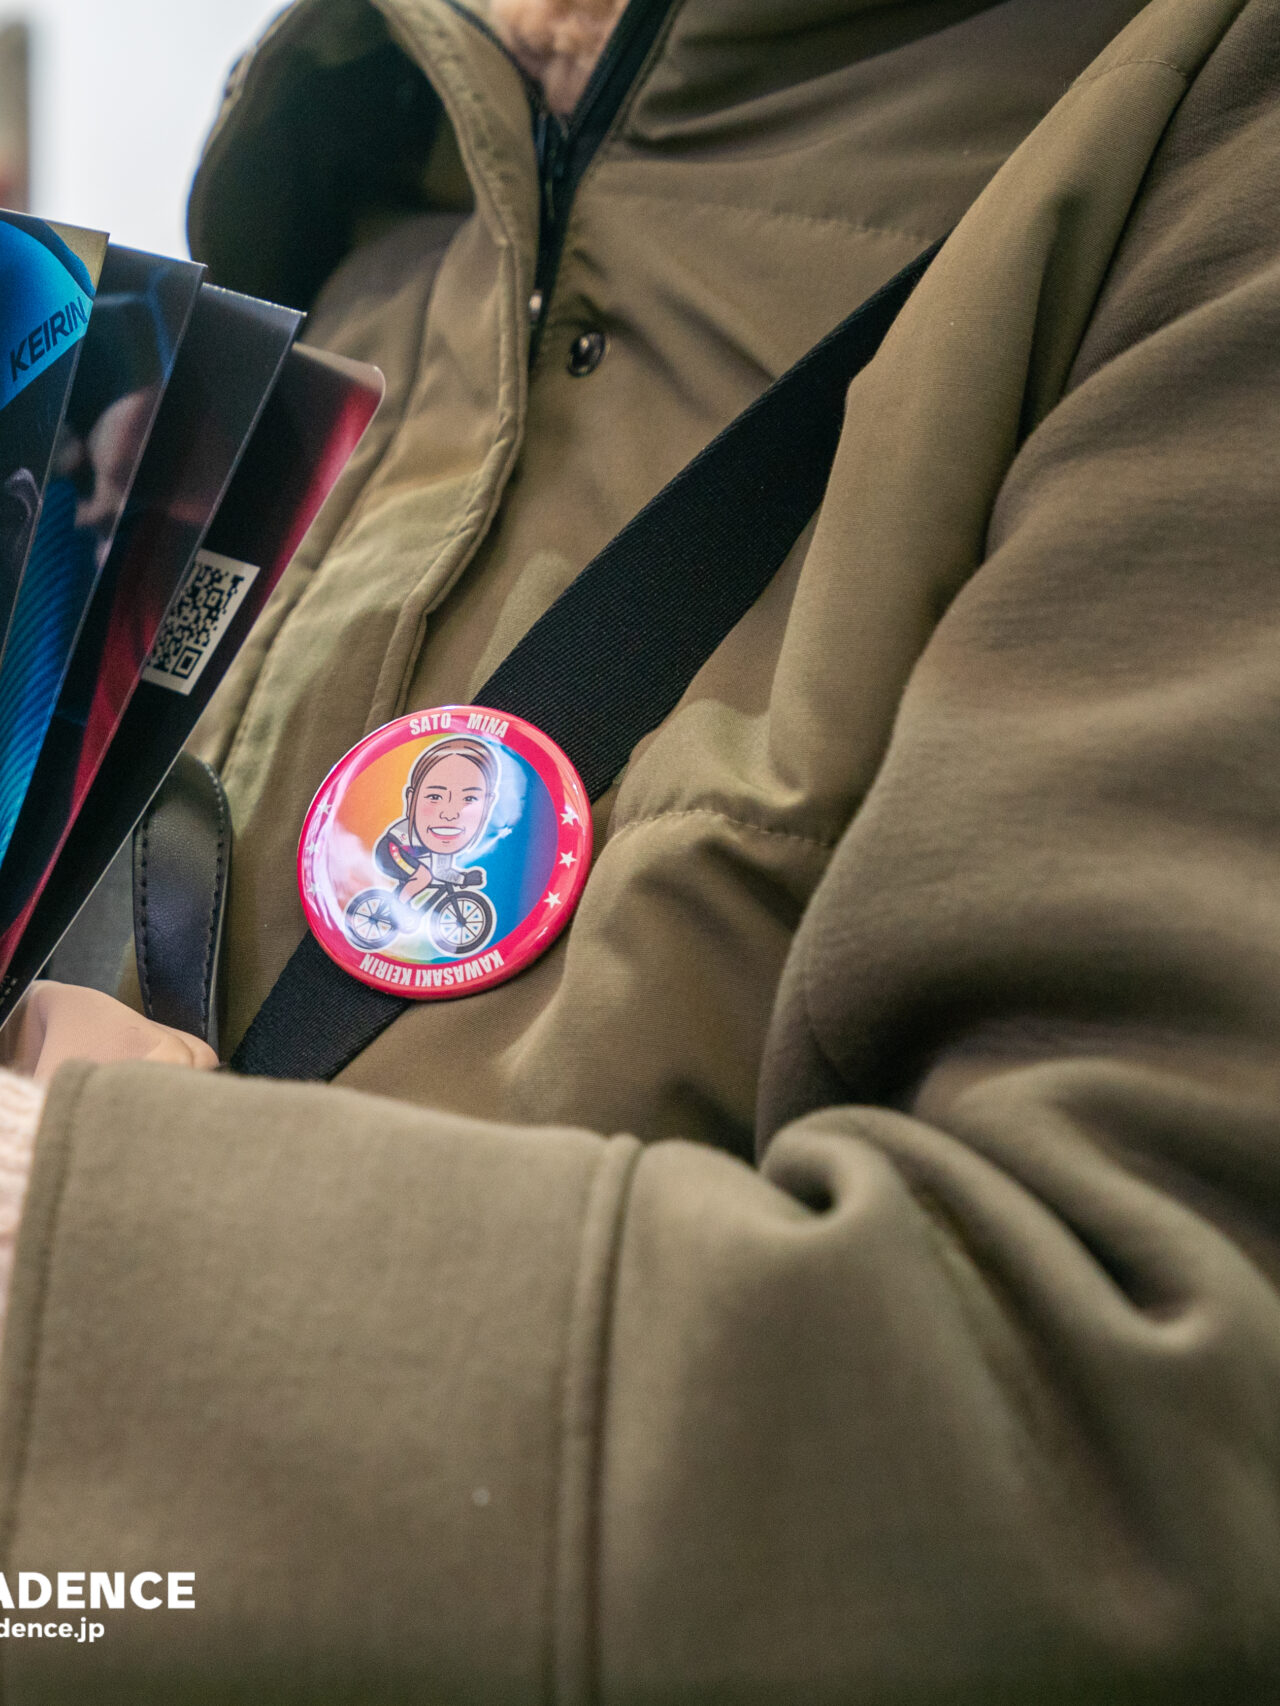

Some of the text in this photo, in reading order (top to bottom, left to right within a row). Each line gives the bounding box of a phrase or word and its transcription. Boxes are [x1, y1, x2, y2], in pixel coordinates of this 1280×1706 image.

[10, 296, 88, 382] KEIRIN
[409, 712, 510, 739] SATO MINA
[359, 949, 505, 987] KAWASAKI KEIRIN
